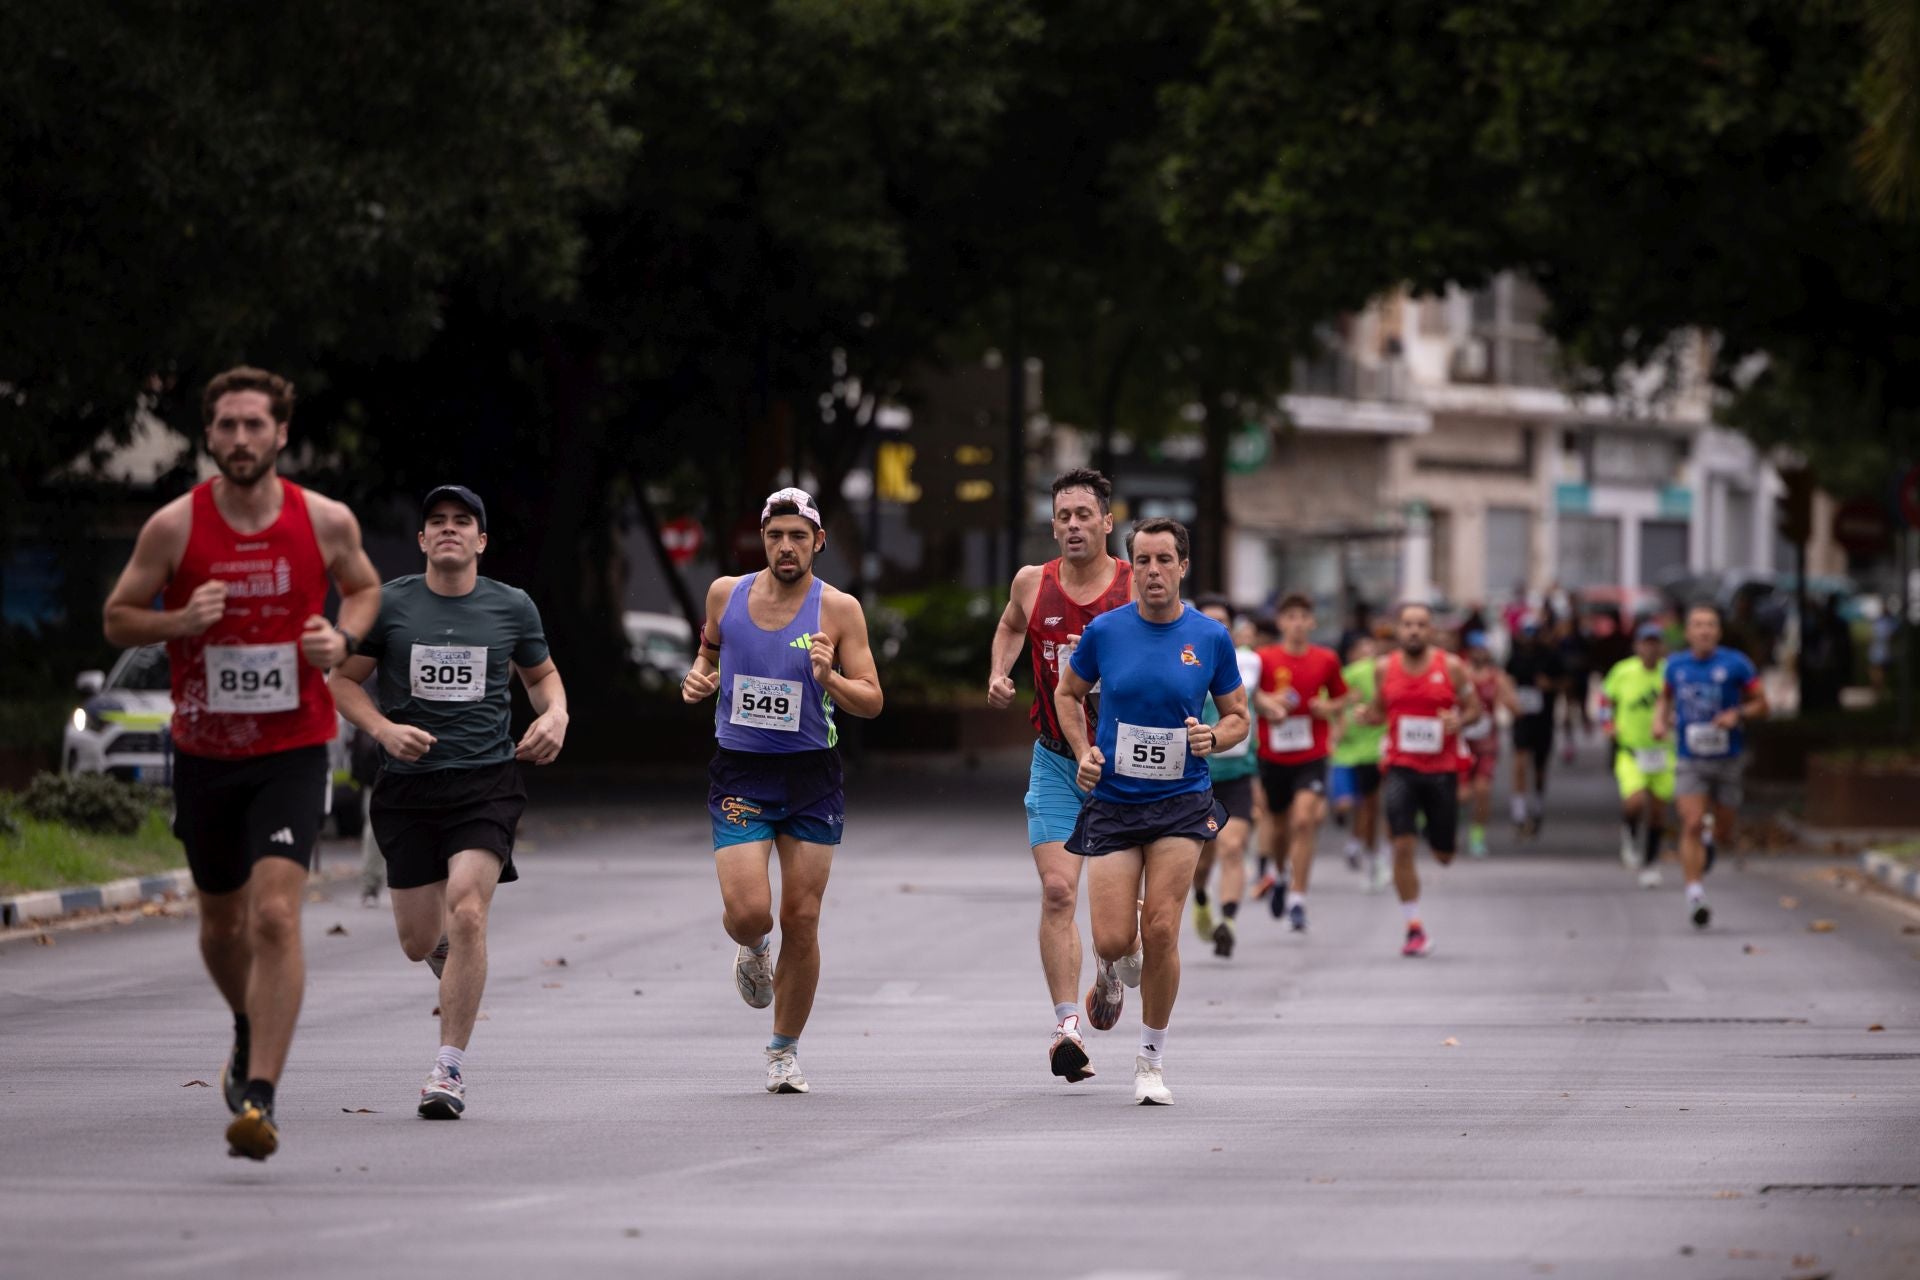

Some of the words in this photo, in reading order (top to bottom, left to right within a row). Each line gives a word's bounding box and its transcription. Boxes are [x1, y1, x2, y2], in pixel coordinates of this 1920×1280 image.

[220, 668, 282, 692] 894
[420, 665, 472, 684] 305
[742, 693, 789, 715] 549
[1132, 744, 1166, 764] 55
